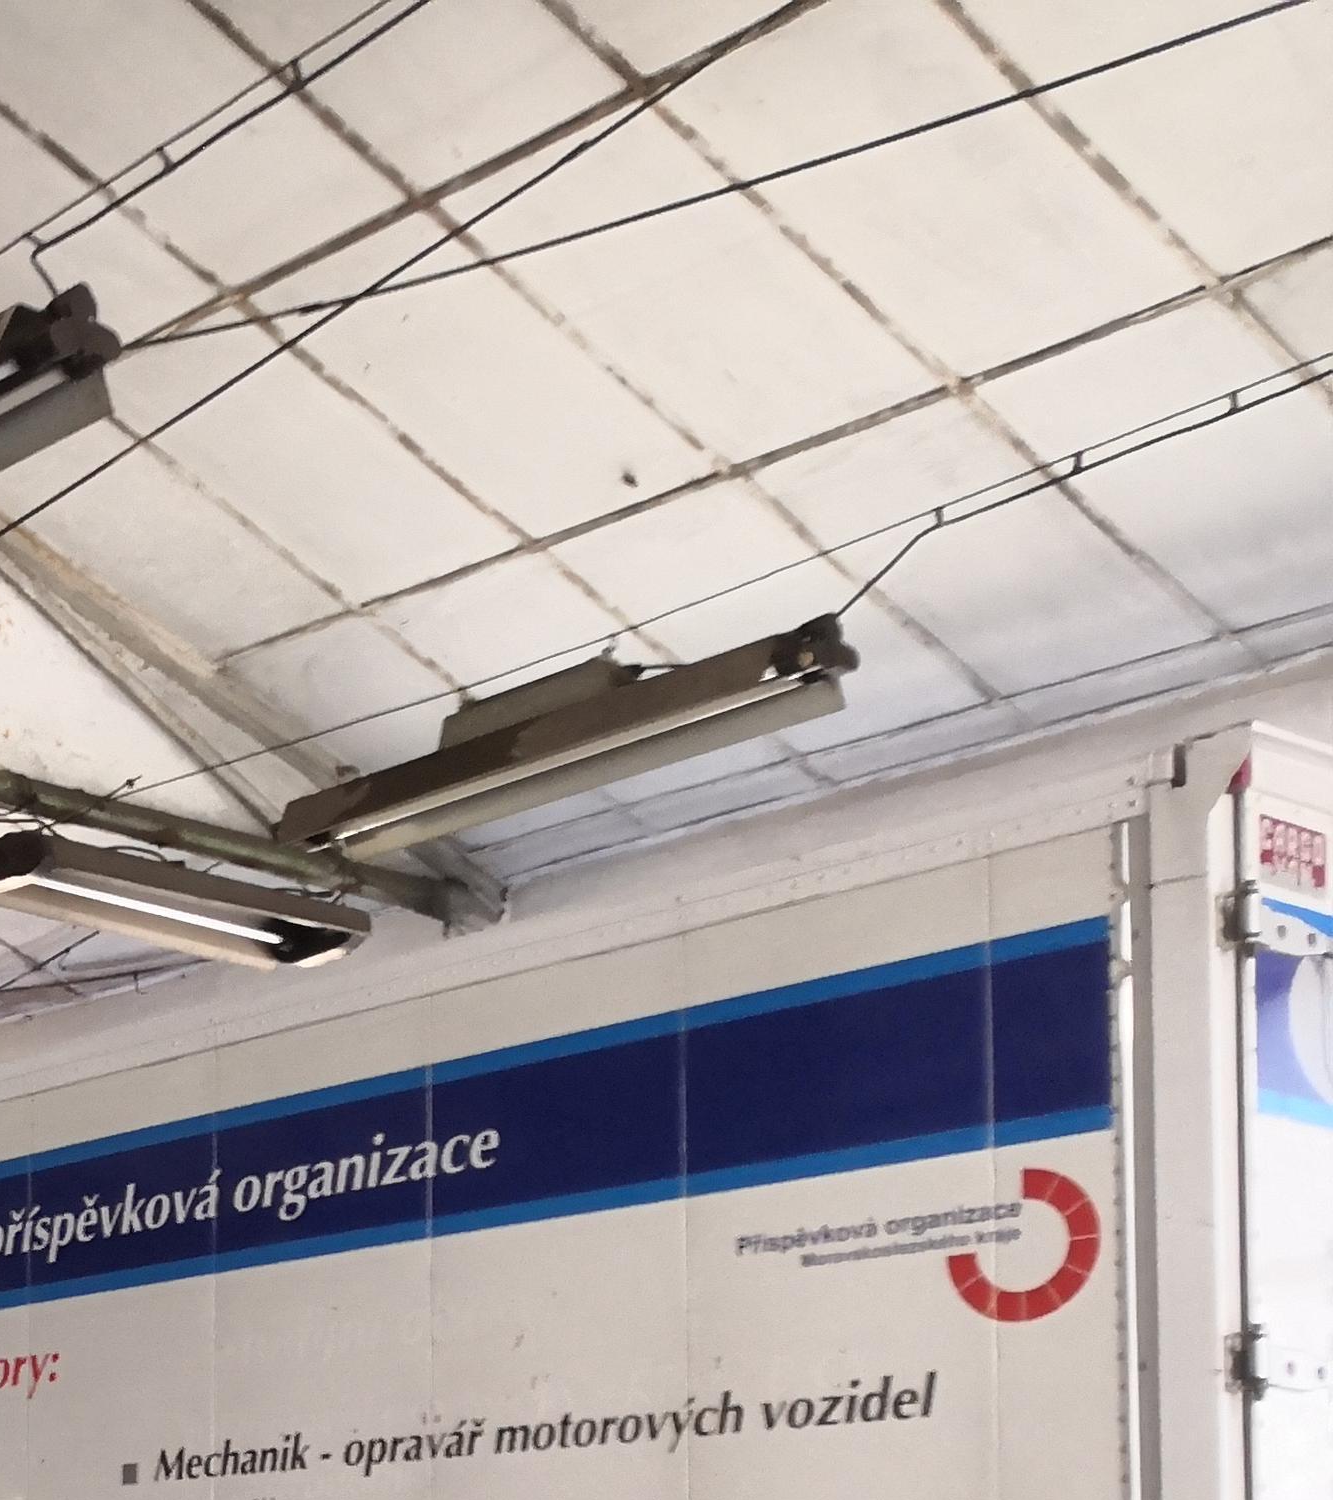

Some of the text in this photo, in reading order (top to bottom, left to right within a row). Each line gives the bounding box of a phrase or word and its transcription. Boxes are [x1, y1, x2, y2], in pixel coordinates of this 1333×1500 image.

[232, 1128, 501, 1221] organizace
[884, 1202, 1023, 1236] organizace
[154, 1431, 311, 1483] Mechanik
[343, 1416, 487, 1478] opravář
[494, 1389, 745, 1455] motorových
[762, 1368, 938, 1431] vozidel
